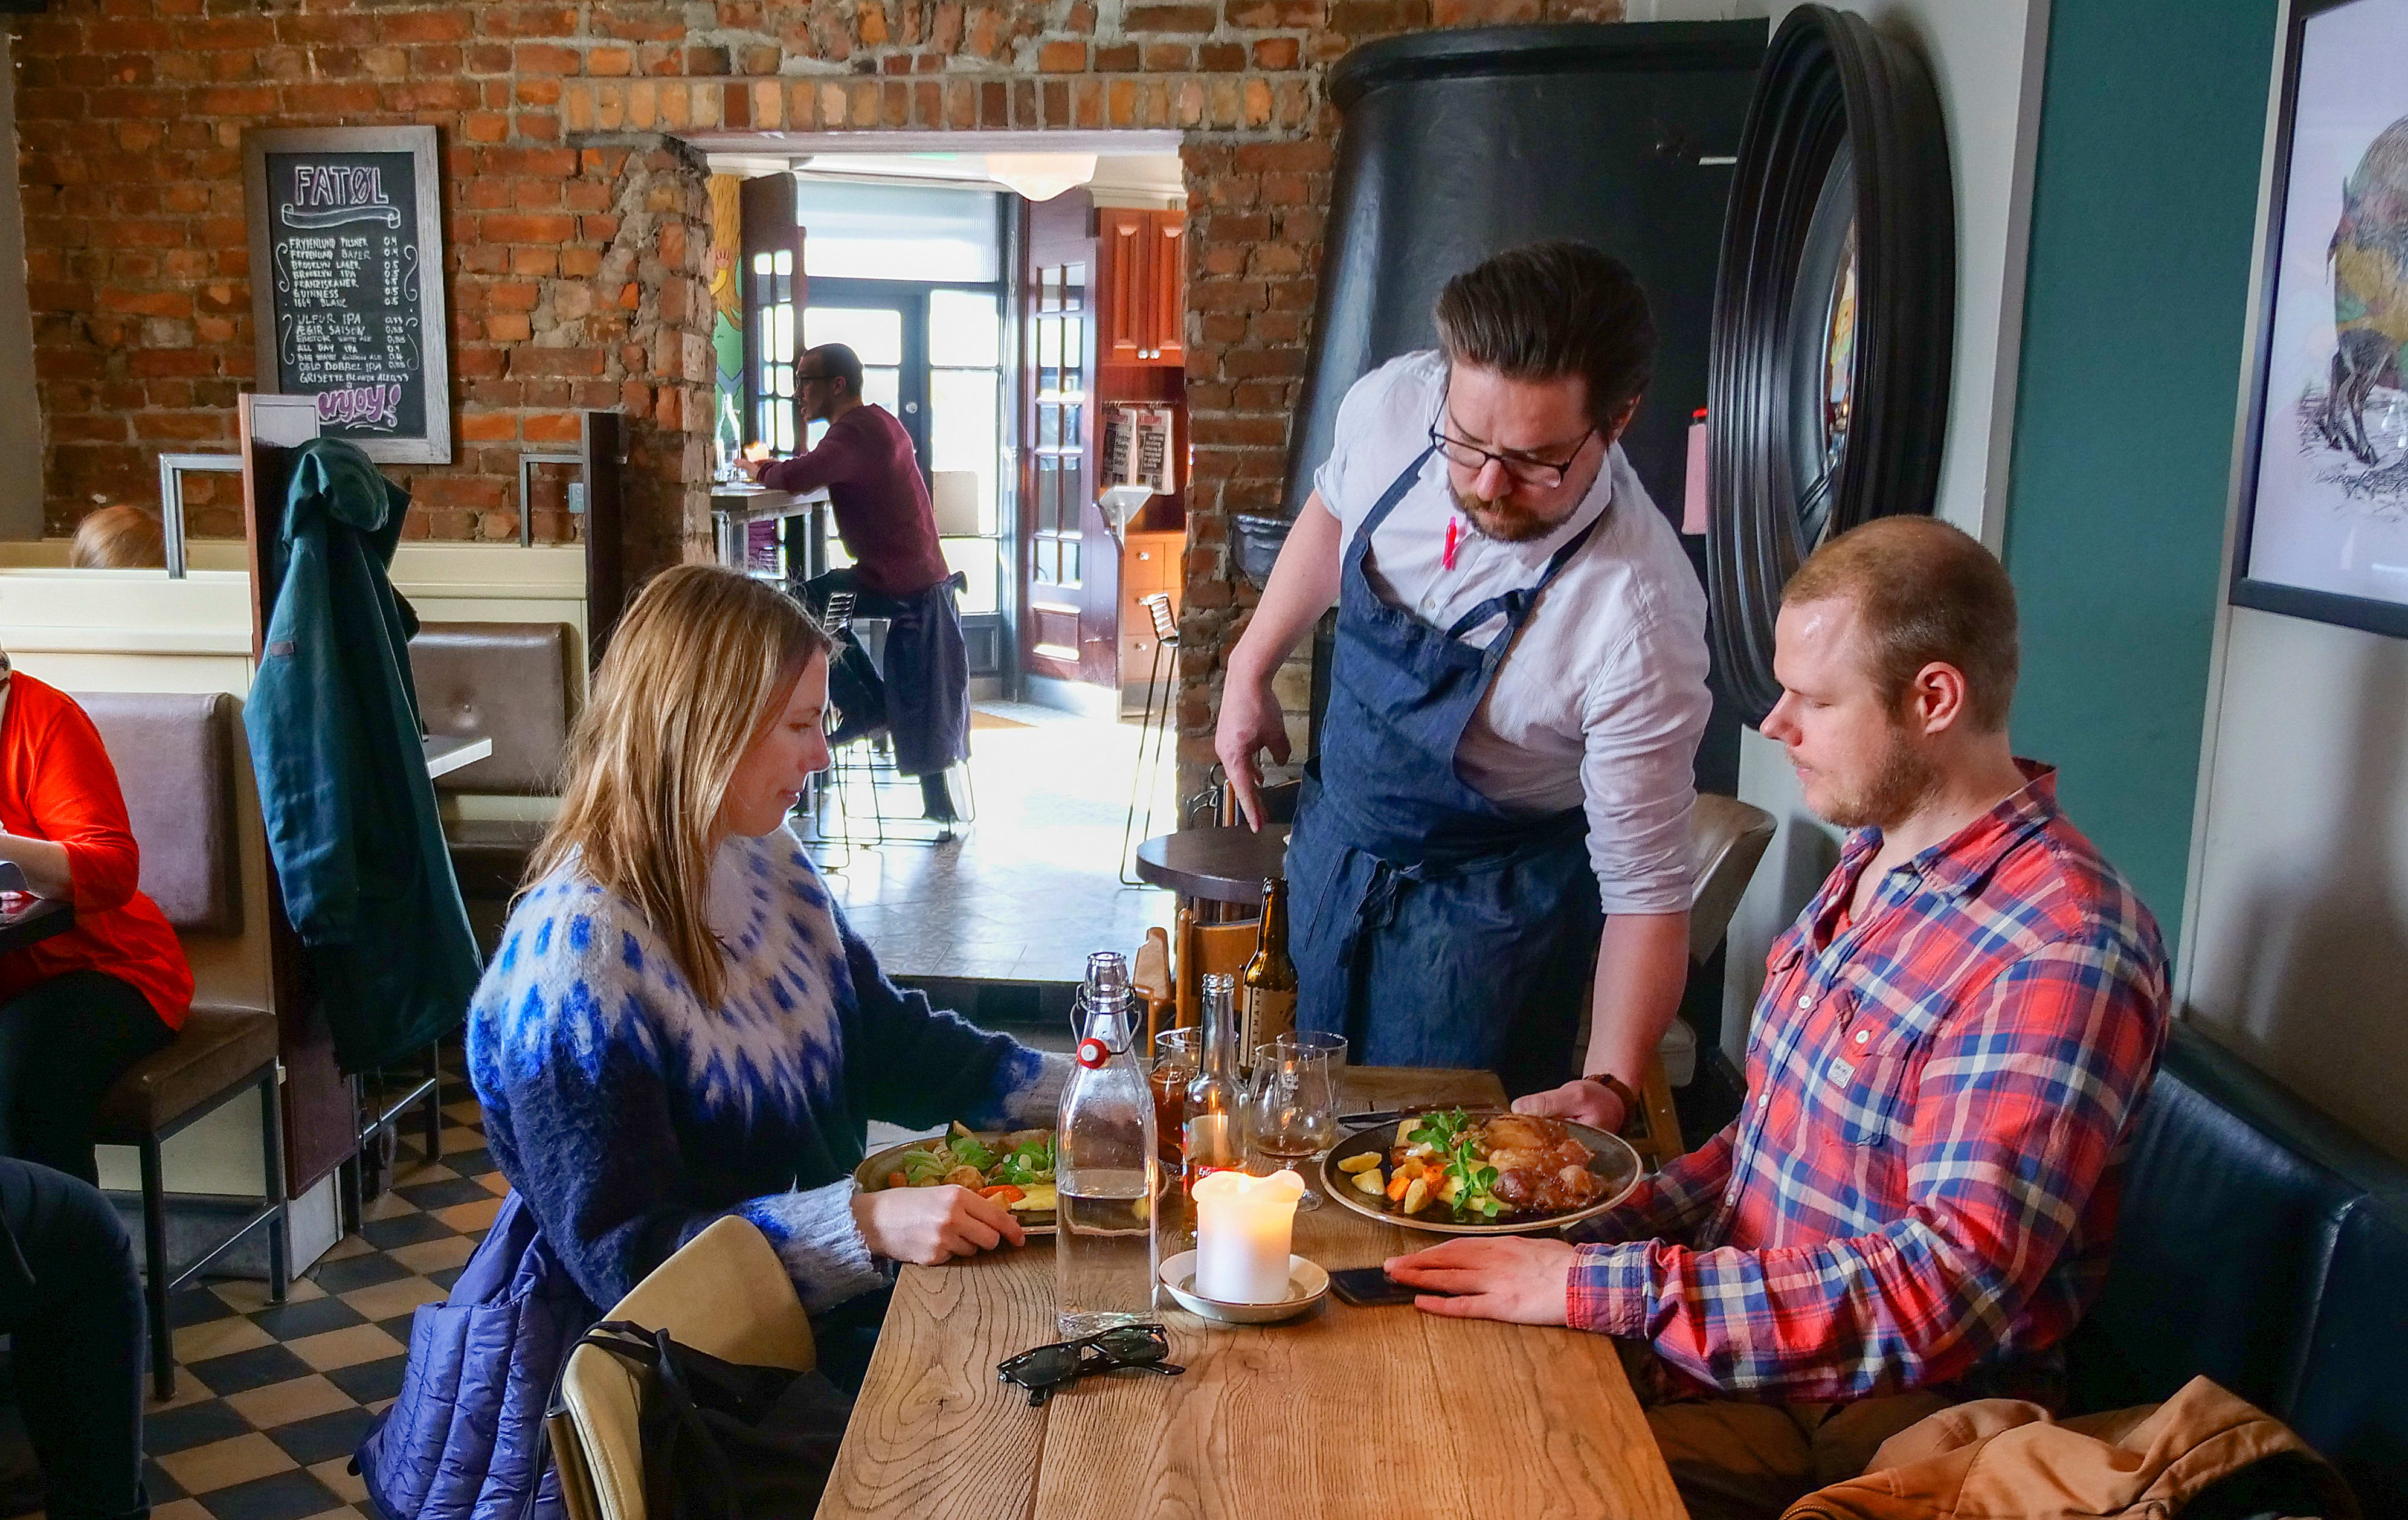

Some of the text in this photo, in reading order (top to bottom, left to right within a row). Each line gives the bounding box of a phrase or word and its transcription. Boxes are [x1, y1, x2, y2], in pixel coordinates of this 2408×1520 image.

[295, 166, 389, 206] FATØL
[340, 269, 356, 278] IPA
[294, 288, 339, 298] GUINNESS
[294, 298, 312, 308] 1664
[320, 298, 347, 308] BLANC
[342, 313, 361, 325] IPA
[329, 325, 366, 336] SAISON
[297, 344, 313, 353] ALL
[318, 344, 335, 353] DAY
[344, 344, 358, 353] IPA
[297, 353, 313, 362] BIG
[365, 362, 382, 373] IPA
[300, 372, 344, 383] GRISETTE
